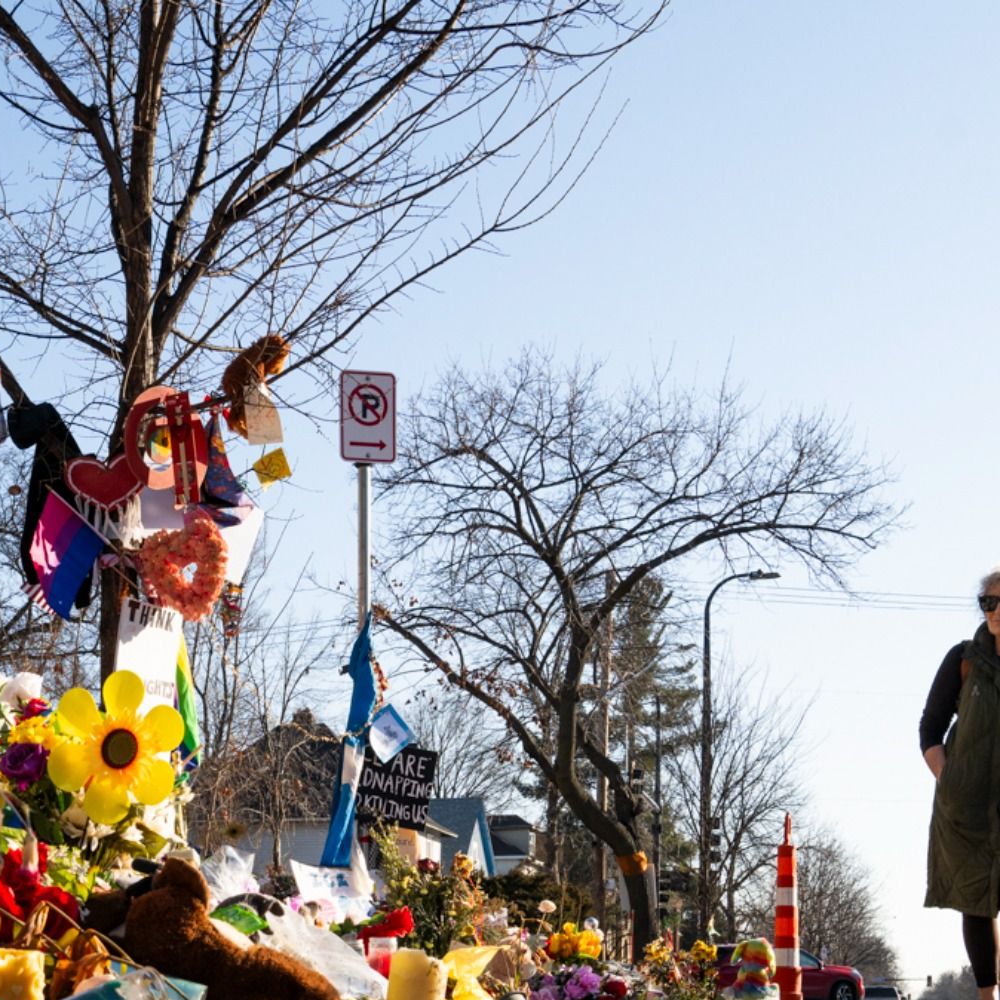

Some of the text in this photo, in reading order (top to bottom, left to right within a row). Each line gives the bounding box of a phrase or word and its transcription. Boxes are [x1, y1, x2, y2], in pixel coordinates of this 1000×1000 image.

[128, 600, 176, 632] THINK
[391, 752, 432, 779] ARE
[360, 767, 433, 800] DNAPPING
[411, 804, 429, 824] US
